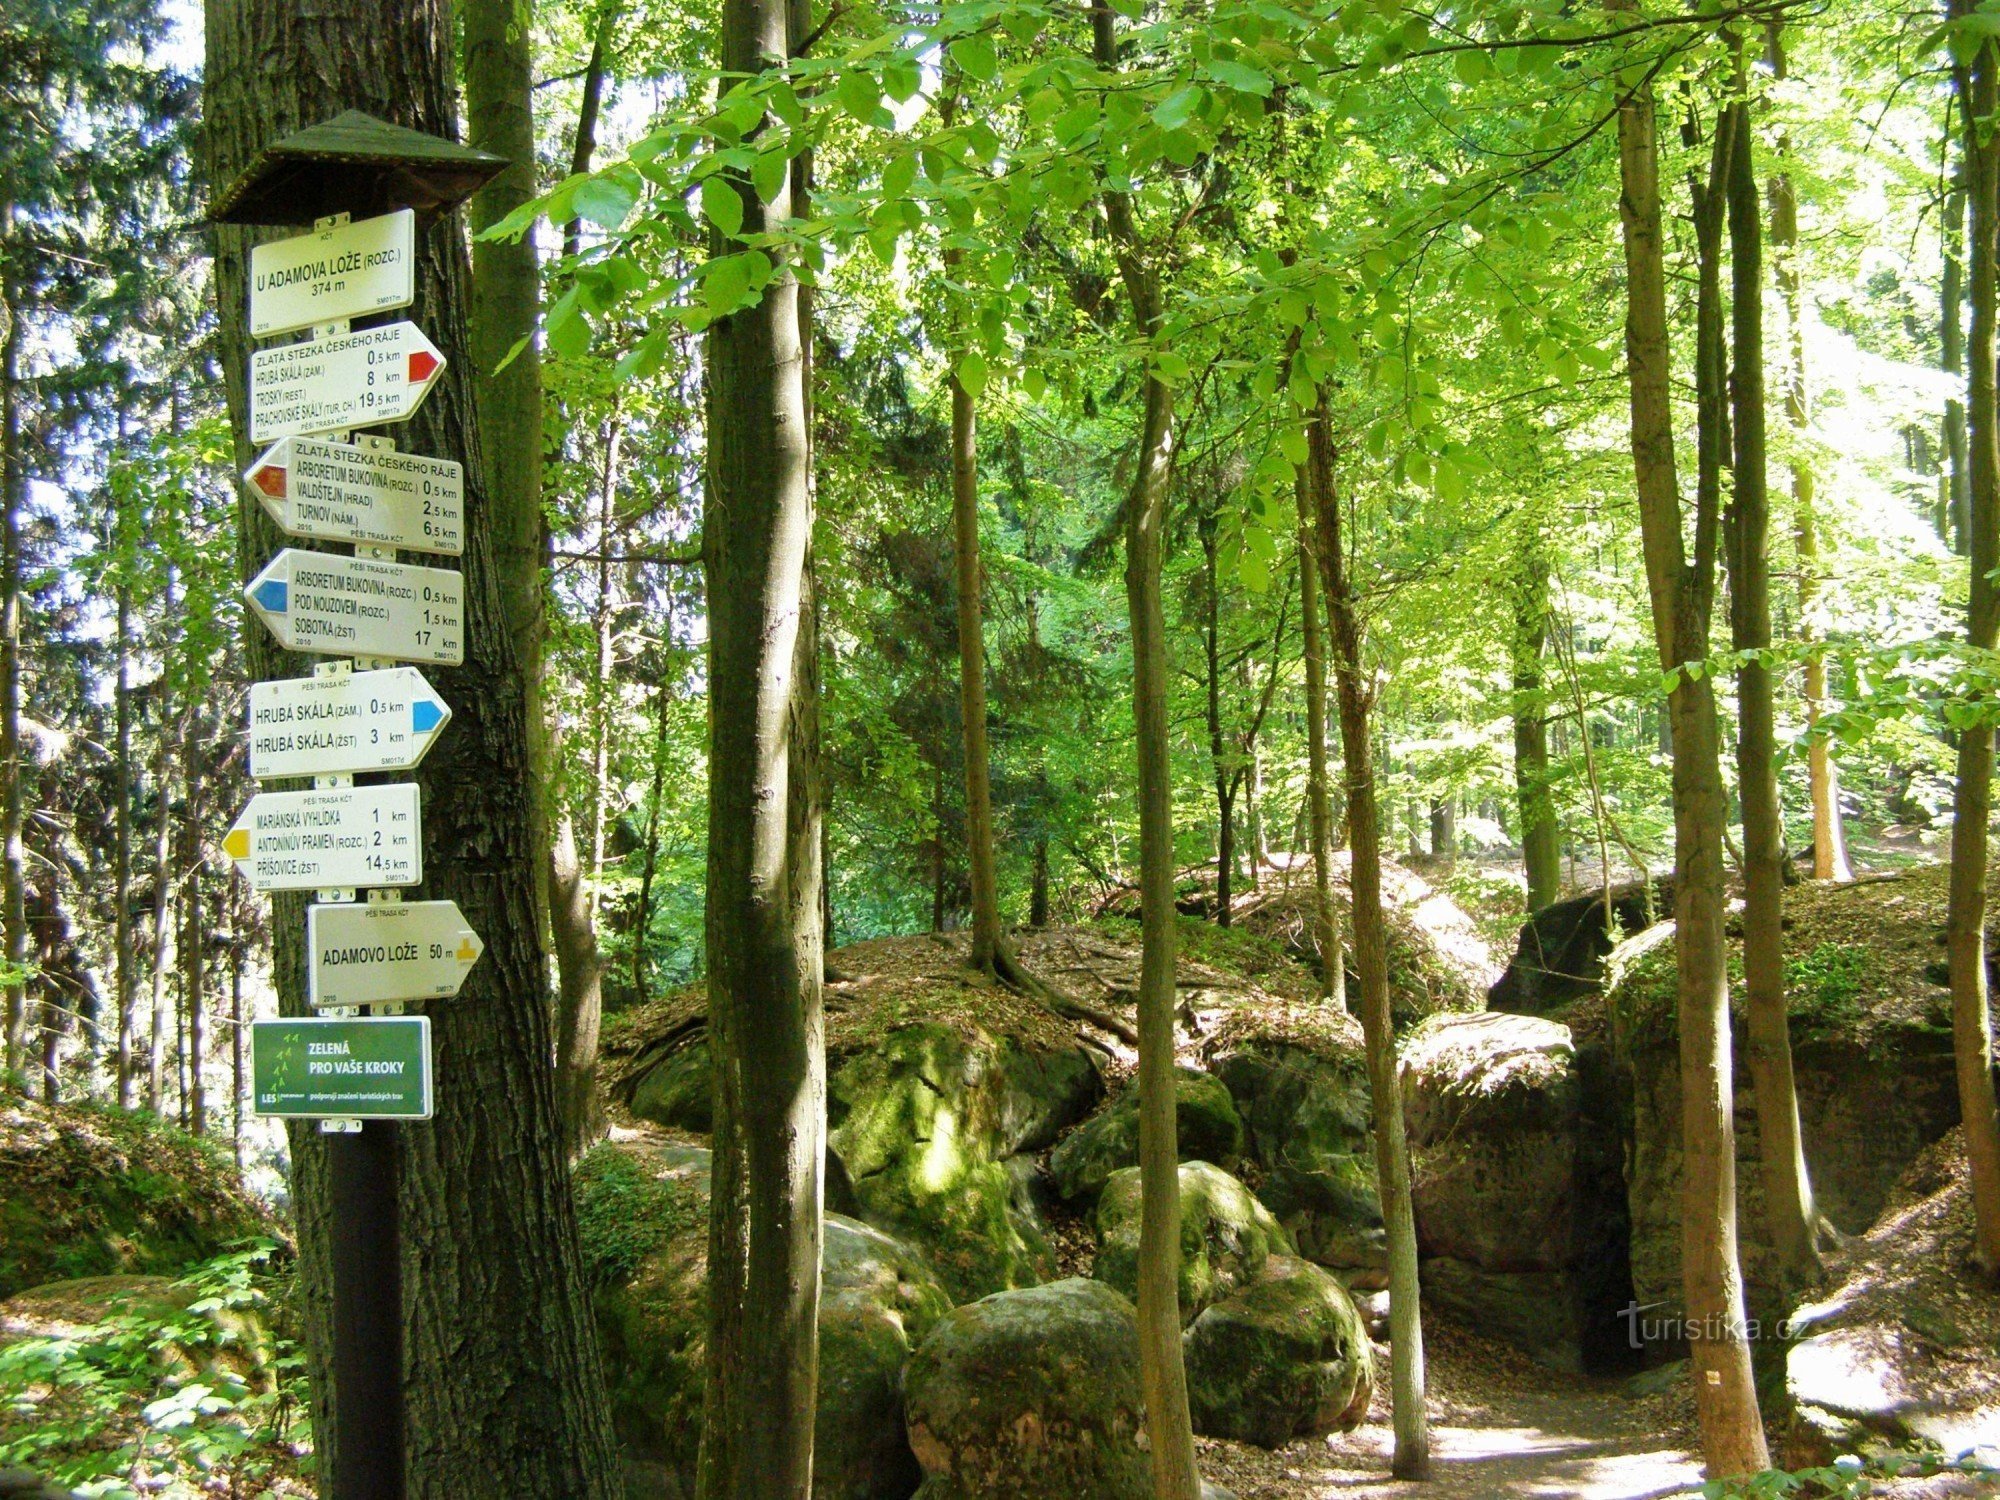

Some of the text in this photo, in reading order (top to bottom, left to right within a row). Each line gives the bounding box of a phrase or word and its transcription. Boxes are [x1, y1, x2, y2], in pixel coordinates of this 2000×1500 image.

[258, 249, 400, 291] U ADAMOVA LOŽE (ROZC.)
[312, 280, 345, 296] 374 m
[257, 330, 400, 367] ZLATÁ STEZKA ČESKÉHO RÁJE
[256, 350, 400, 387] HRUBÁ SKÁLA (ZÁM.) 0,5 km
[256, 371, 400, 407] TROSKY (REST.) 8 km
[256, 405, 300, 428] PRACHOVSKÉ
[301, 401, 323, 420] SKÁLY
[360, 392, 382, 408] 19,5
[386, 393, 400, 403] km
[317, 419, 335, 428] TRASA
[296, 443, 456, 478] ZLATÁ STEZKA ČESKÉHO RÁJE
[297, 461, 457, 499] ARBORETUM BUKOVINA (ROZC.) 0,5 km
[297, 481, 457, 518] VALDŠTEJN (HRAD) 2,5 km
[297, 504, 457, 539] TURNOV (NÁM.) 6,5 km
[368, 532, 389, 542] TRASA
[367, 566, 388, 574] TRASA
[296, 571, 457, 604] ARBORETUM BUKOVINA (ROZC.) 0,5 km
[295, 594, 457, 626] POD NOUZOVEM (ROZC.) 1,5 km
[295, 618, 457, 649] SOBOTKA (ŽST) 17 km
[317, 681, 337, 690] TRASA
[256, 699, 404, 724] HRUBÁ SKÁLA (ZÁM.) 0,5 km
[256, 729, 404, 753] HRUBÁ SKÁLA (ŽST) 3 km
[340, 795, 352, 803] KČT
[257, 808, 406, 830] MARIÁNSKÁ VYHLÍDKA 1 km
[257, 831, 407, 852] ANTONÍNŮV PRAMEN (ROZC.) 2 km
[257, 855, 408, 876] PŘÍŠOVICE (ŽST) 14,5 km
[323, 947, 385, 965] ADAMOVO
[389, 943, 418, 961] LOŽE
[430, 944, 442, 959] 50
[309, 1041, 349, 1055] ZELENÁ
[310, 1059, 404, 1073] PRO VAŠE KROKY
